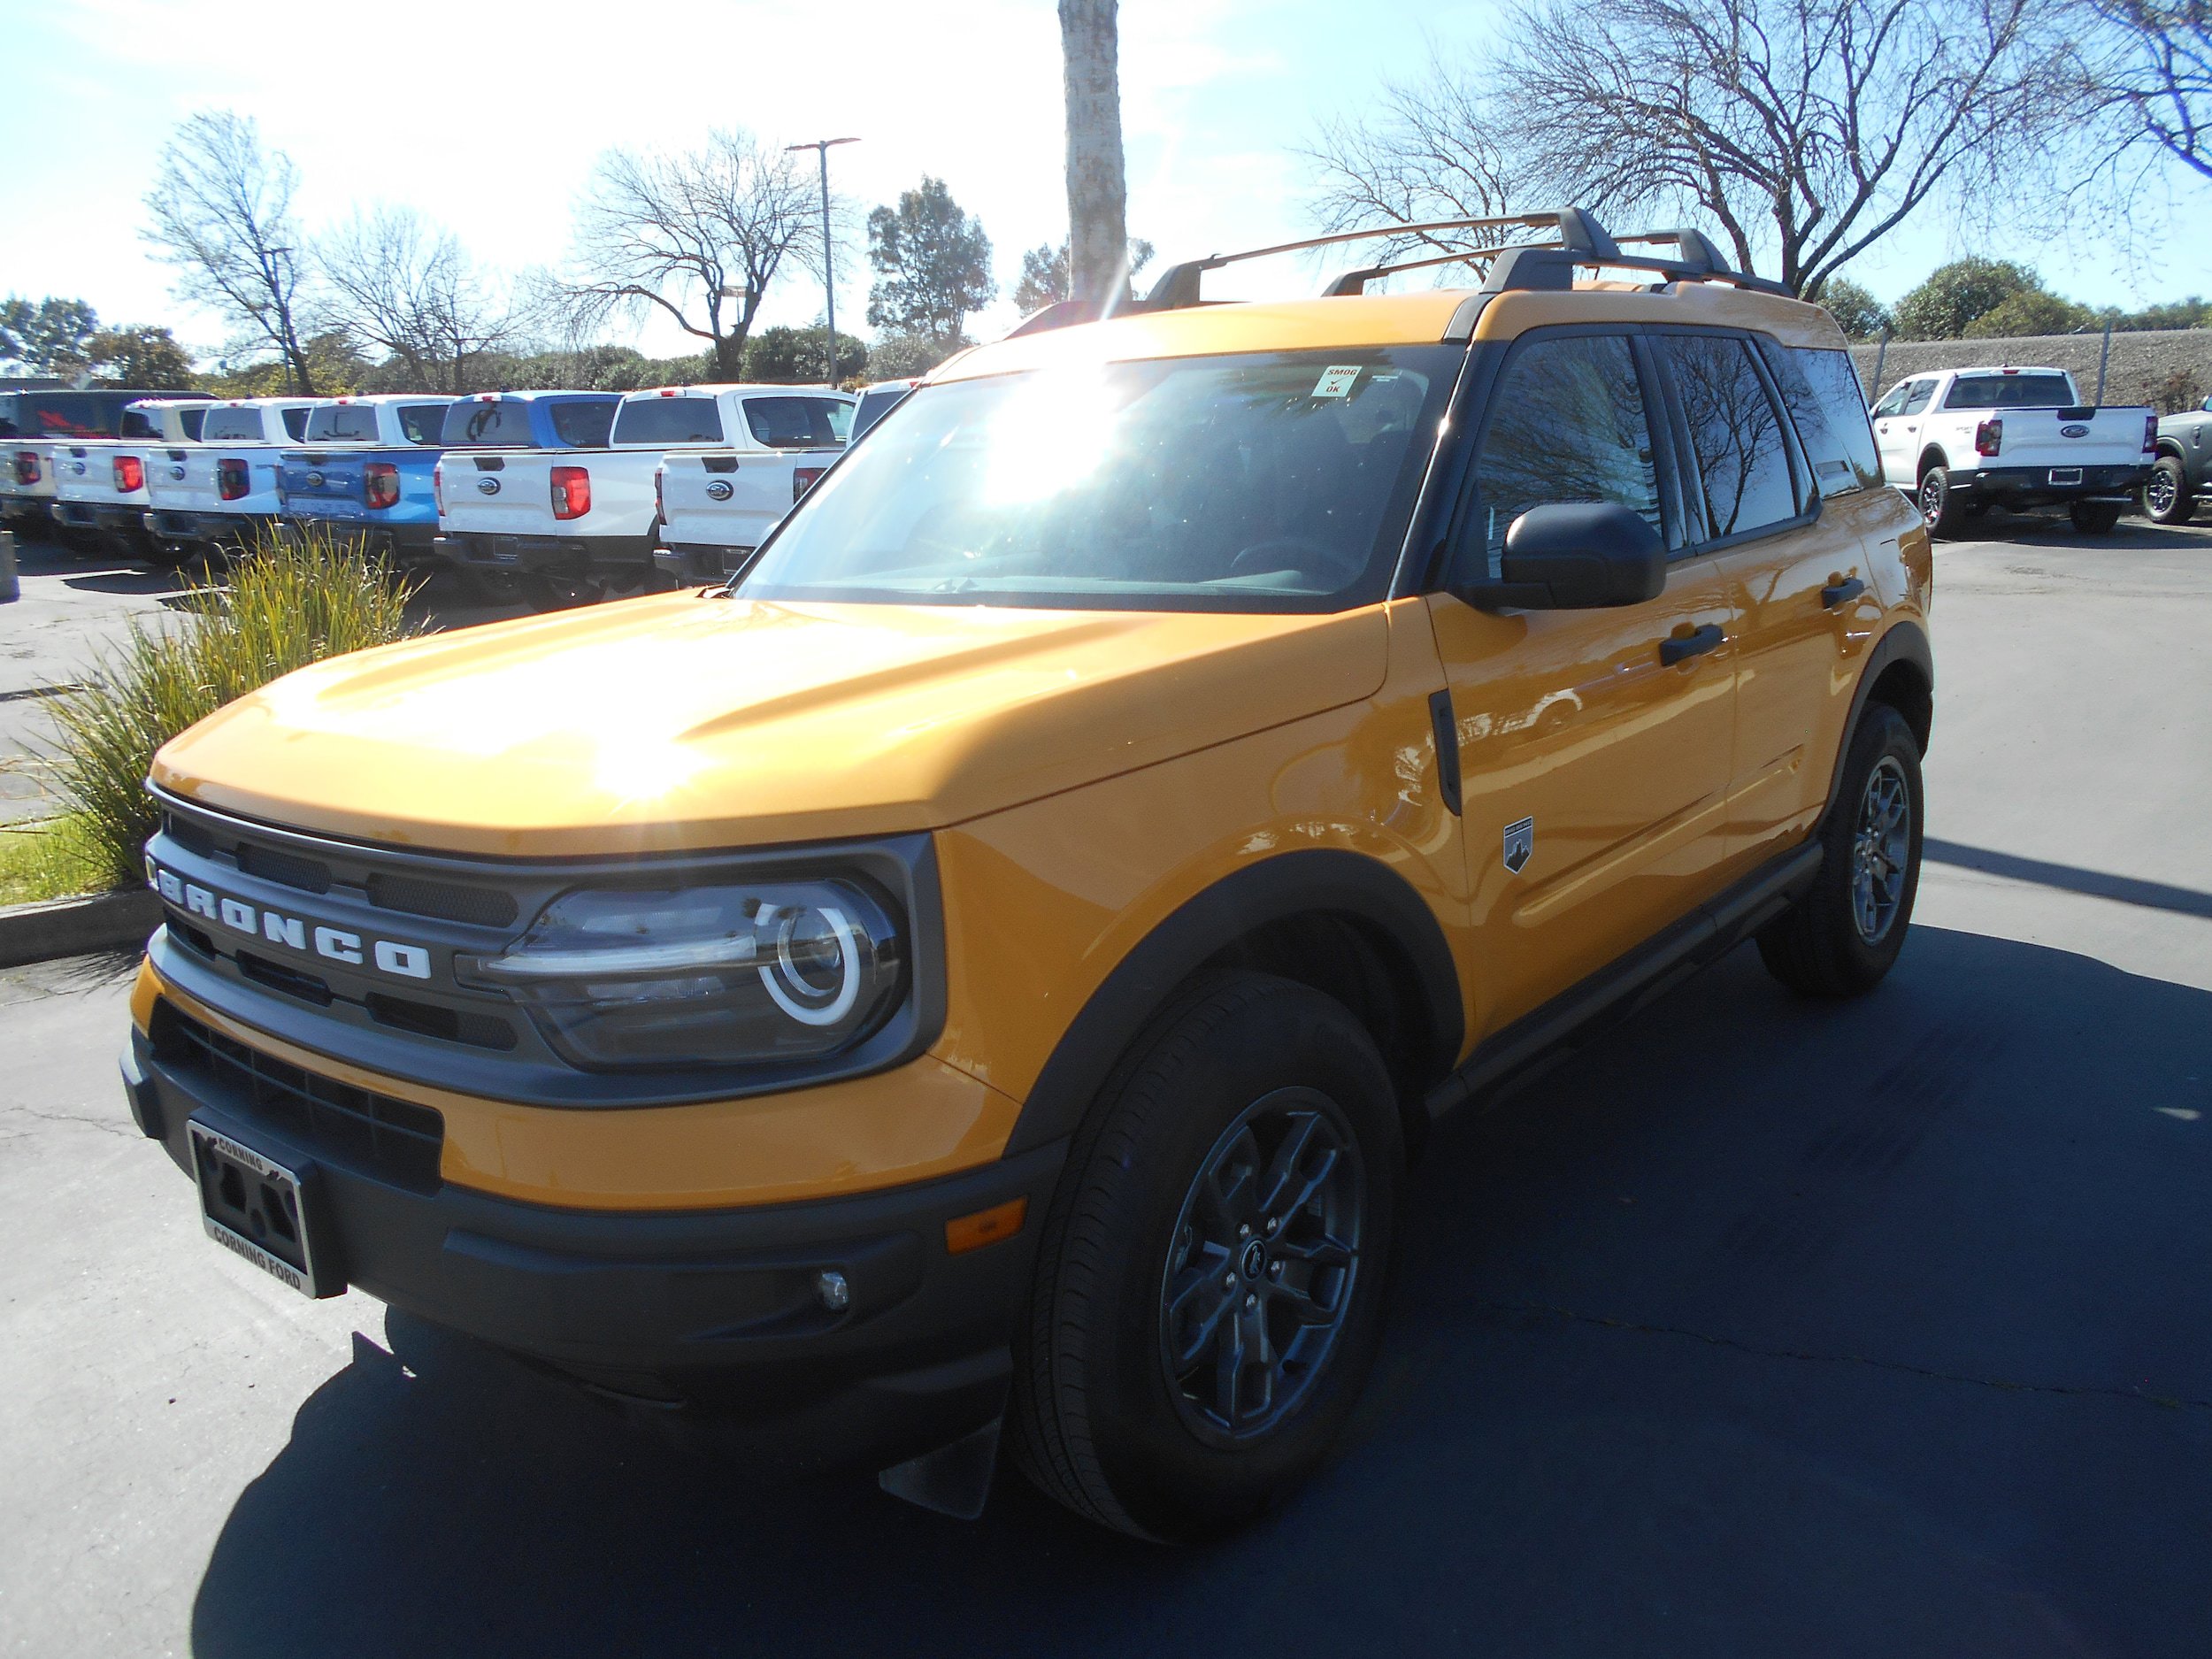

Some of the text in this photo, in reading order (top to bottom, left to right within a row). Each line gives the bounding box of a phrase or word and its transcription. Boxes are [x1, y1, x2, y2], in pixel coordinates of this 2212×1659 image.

[157, 868, 432, 979] BRONCO
[219, 1137, 264, 1171] CORNING
[214, 1226, 302, 1290] CORNING FORD
